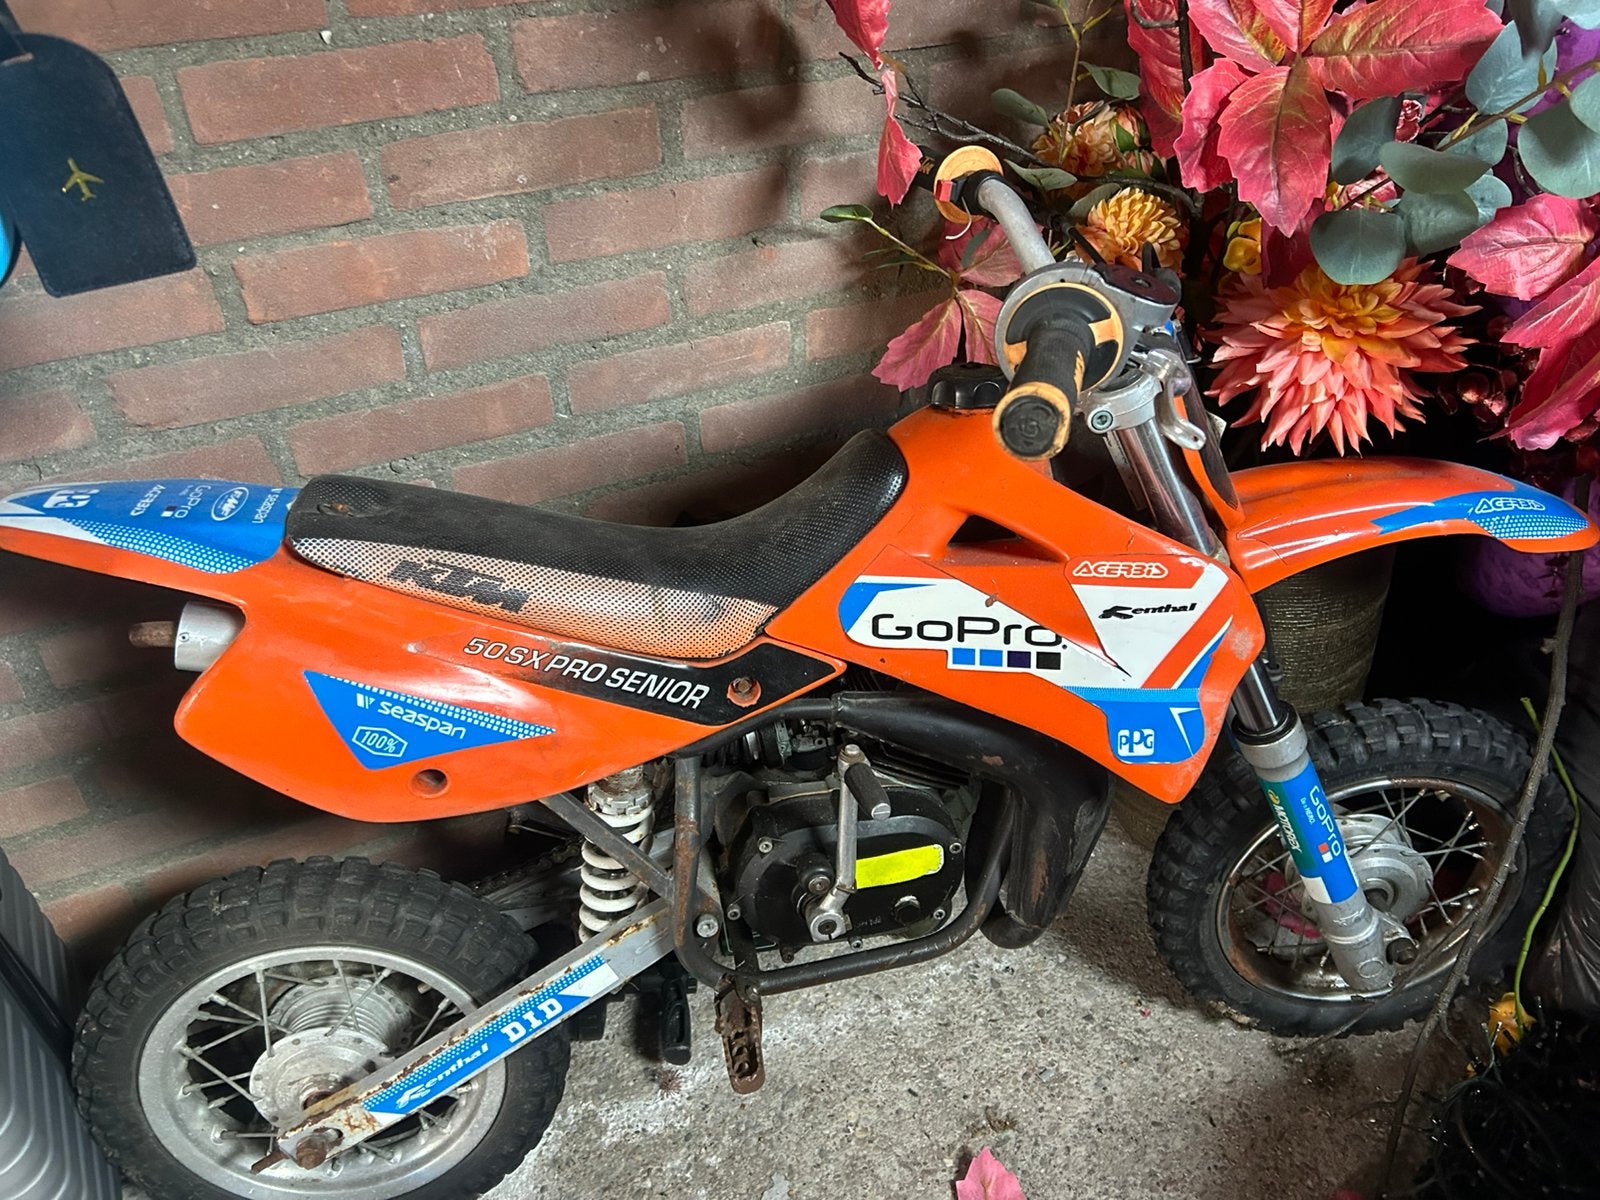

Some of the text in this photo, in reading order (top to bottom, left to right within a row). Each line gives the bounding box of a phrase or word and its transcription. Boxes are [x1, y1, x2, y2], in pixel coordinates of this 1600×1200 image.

[387, 560, 530, 613] KTM
[871, 614, 1062, 646] GoPro
[544, 654, 608, 684] PRO
[605, 668, 710, 710] SENIOR
[377, 701, 466, 739] seaspan
[1118, 728, 1155, 755] PPG
[360, 731, 399, 753] 100%
[1273, 804, 1302, 853] MOTOREX
[1310, 785, 1341, 856] GoPro
